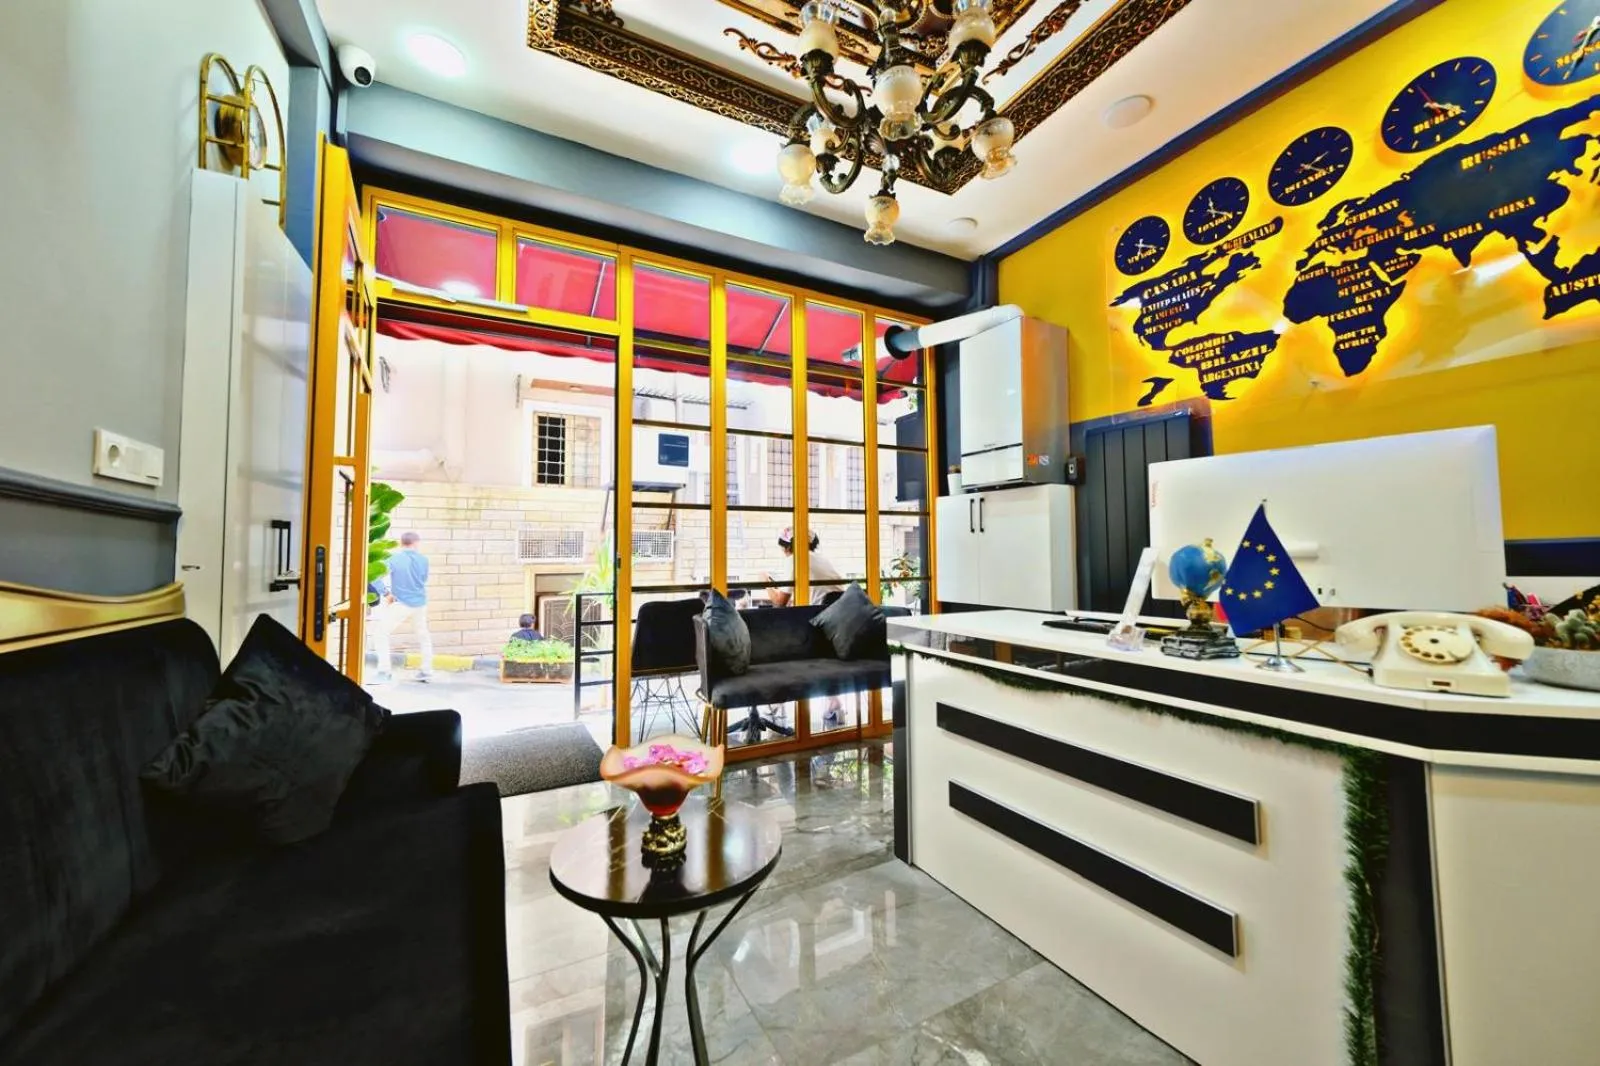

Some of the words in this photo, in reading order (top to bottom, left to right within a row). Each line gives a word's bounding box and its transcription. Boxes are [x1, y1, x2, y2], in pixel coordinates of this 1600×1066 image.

[1460, 132, 1531, 171] RUSSIA
[1345, 199, 1400, 226] GERMANY
[1488, 196, 1537, 219] CHINA
[1198, 212, 1233, 233] LONDON
[1404, 224, 1436, 241] IRAN
[1443, 222, 1484, 243] INDIA
[1222, 223, 1277, 250] GREENLAND
[1143, 271, 1198, 300] CANADA
[1338, 281, 1373, 298] SUDAN
[1355, 287, 1391, 304] KENYA
[1550, 273, 1600, 298] AUST
[1142, 298, 1171, 315] UNITED
[1330, 304, 1373, 322] UGANDA
[1143, 315, 1152, 325] OF
[1144, 318, 1182, 336] MEXICO
[1175, 334, 1235, 358] COLOMBIA
[1186, 345, 1225, 364] PERU
[1201, 344, 1272, 371] BRAZIL
[1202, 361, 1263, 384] ARGENTINA
